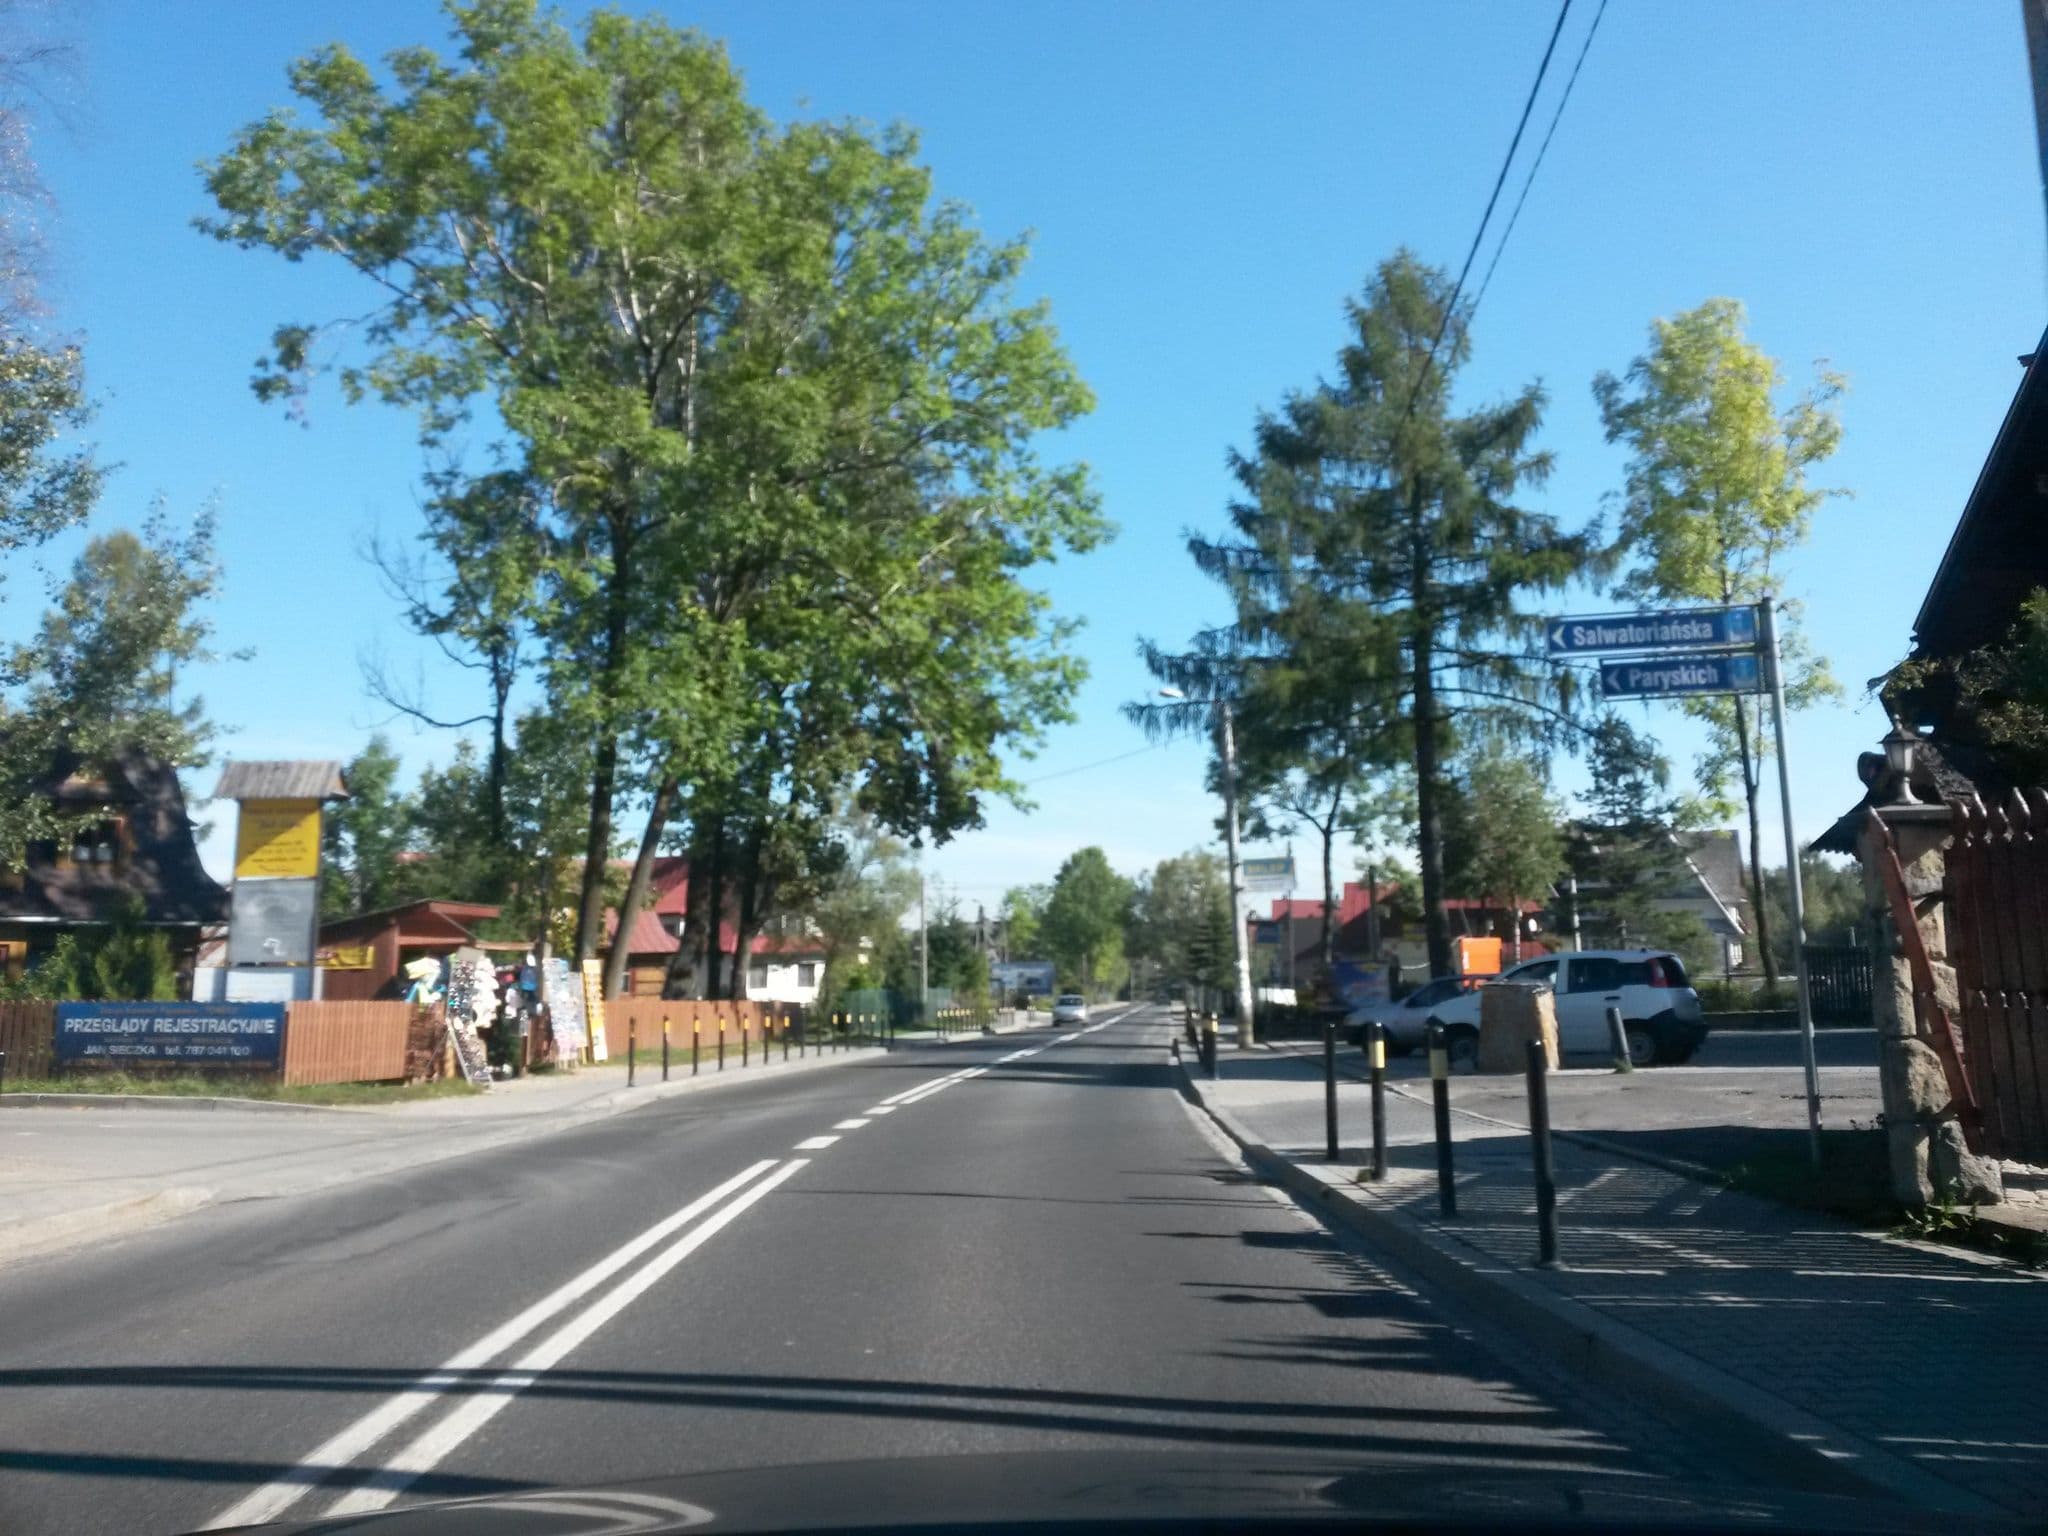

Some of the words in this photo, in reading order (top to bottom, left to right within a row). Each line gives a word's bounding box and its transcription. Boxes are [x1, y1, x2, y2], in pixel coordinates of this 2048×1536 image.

[1573, 621, 1713, 646] Salwatoriańska
[1629, 664, 1718, 690] Paryskich
[64, 1018, 149, 1036] PRZEGLĄDY
[153, 1018, 276, 1034] REJESTRACYJNE
